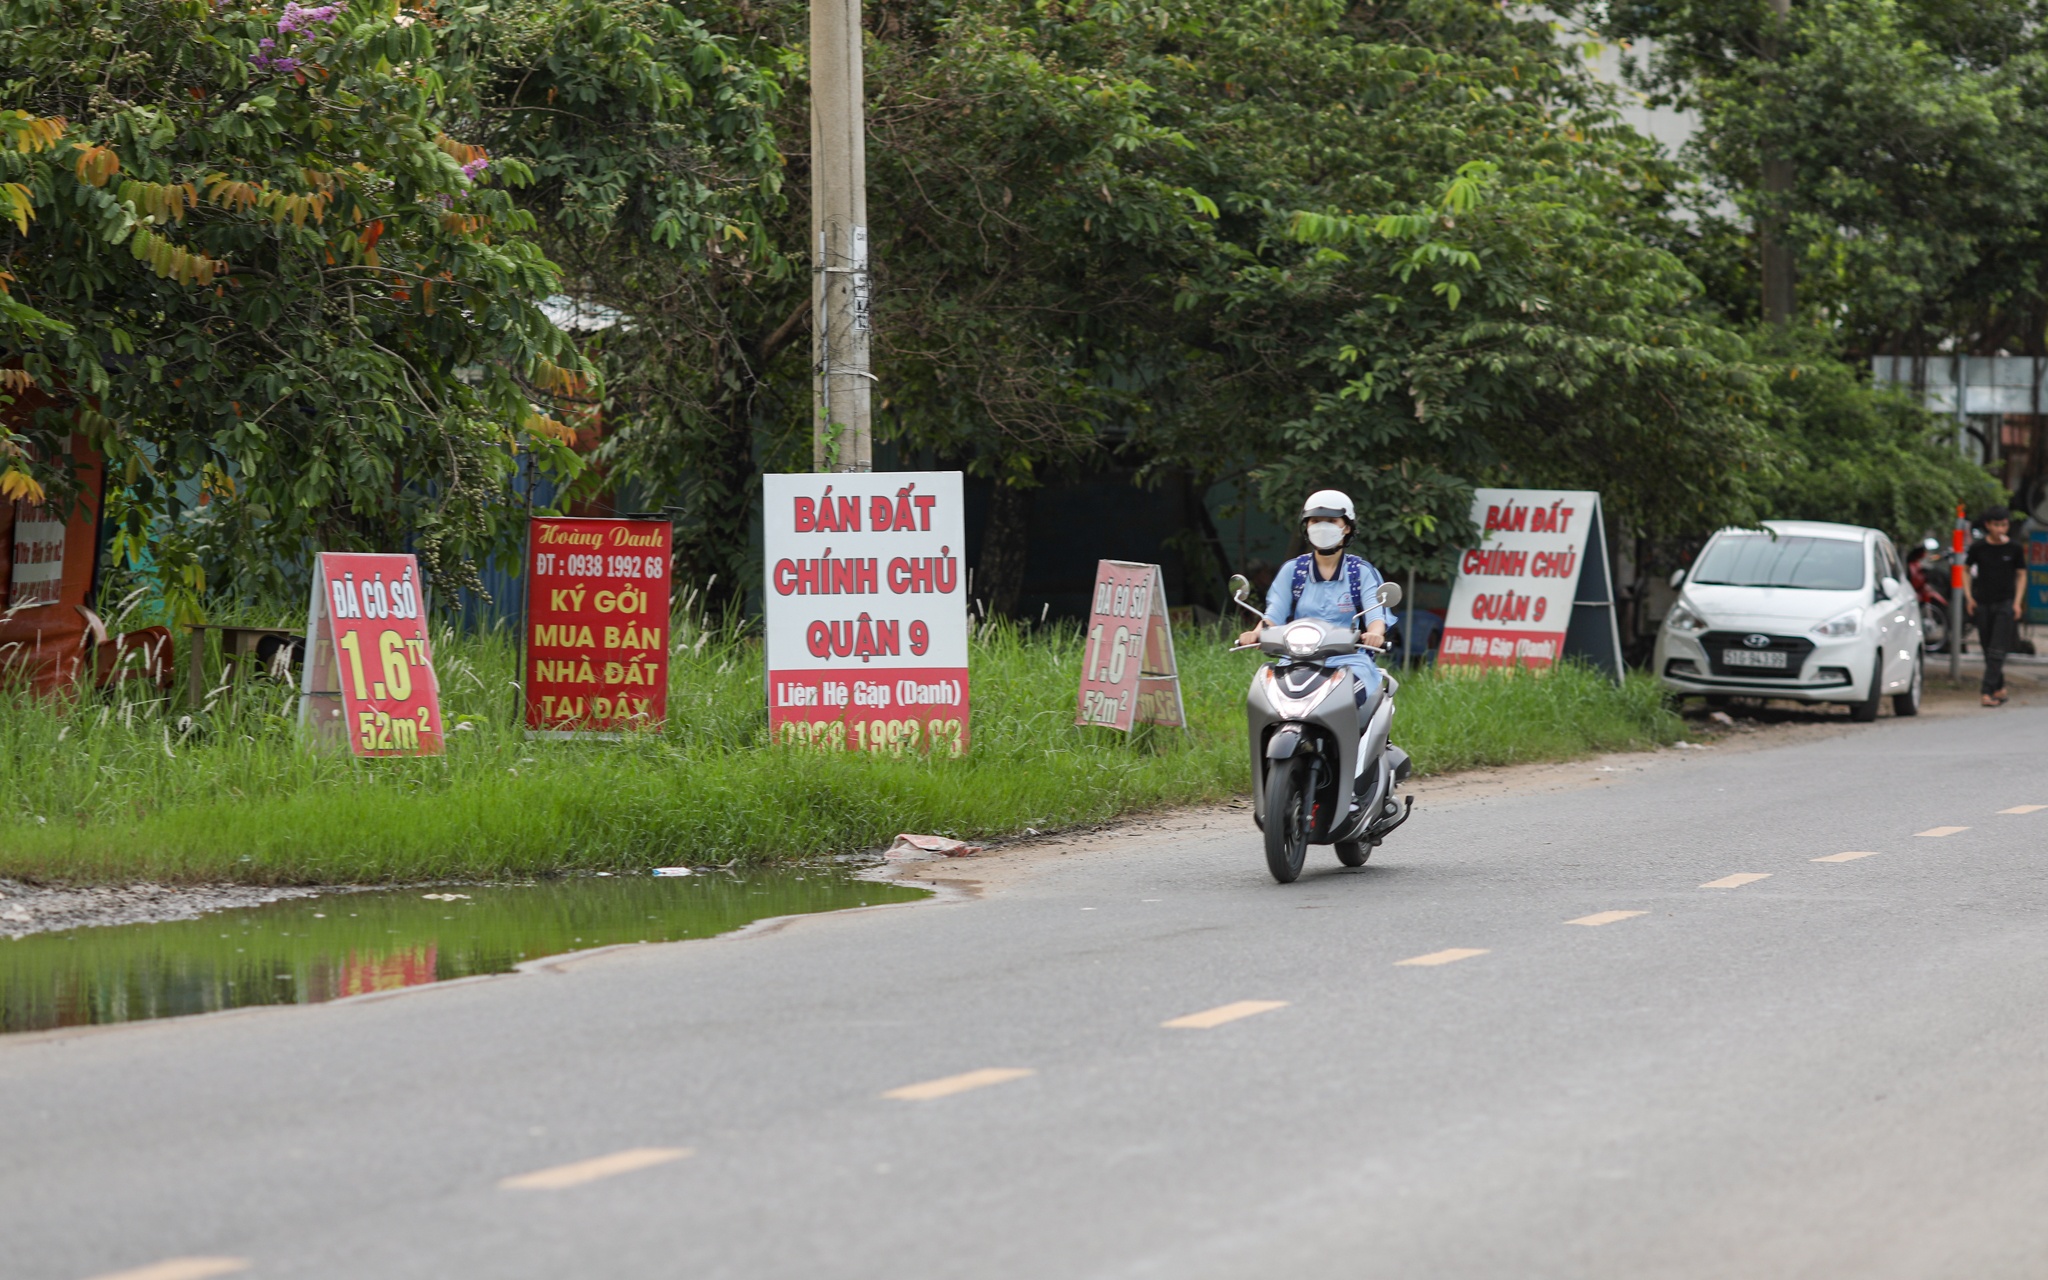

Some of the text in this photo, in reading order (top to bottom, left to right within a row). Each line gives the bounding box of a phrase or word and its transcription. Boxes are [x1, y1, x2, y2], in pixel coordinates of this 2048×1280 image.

[794, 482, 936, 533] BÁN ĐẤT
[1485, 498, 1574, 533] BÁN ĐẤT
[538, 524, 664, 550] Hoàng Danh
[536, 553, 556, 575] ĐT
[567, 554, 603, 577] 0938
[606, 555, 641, 578] 1992
[644, 556, 663, 579] 68
[773, 545, 957, 596] CHÍNH CHỦ
[1463, 542, 1577, 579] CHÍNH CHỦ
[331, 565, 418, 620] ĐÃ CÓ SỔ
[551, 582, 647, 614] KÝ GỞI
[1113, 578, 1131, 618] CÓ
[1471, 589, 1547, 625] QUẬN 9
[534, 620, 661, 650] MUA BÁN
[806, 612, 930, 663] QUẬN 9
[340, 629, 412, 701] 1.6
[535, 652, 659, 685] NHÀ ĐẤT
[1088, 623, 1129, 685] 1.6
[593, 691, 650, 720] ĐÂY
[777, 679, 961, 709] Liên Hệ Gặp (Danh)
